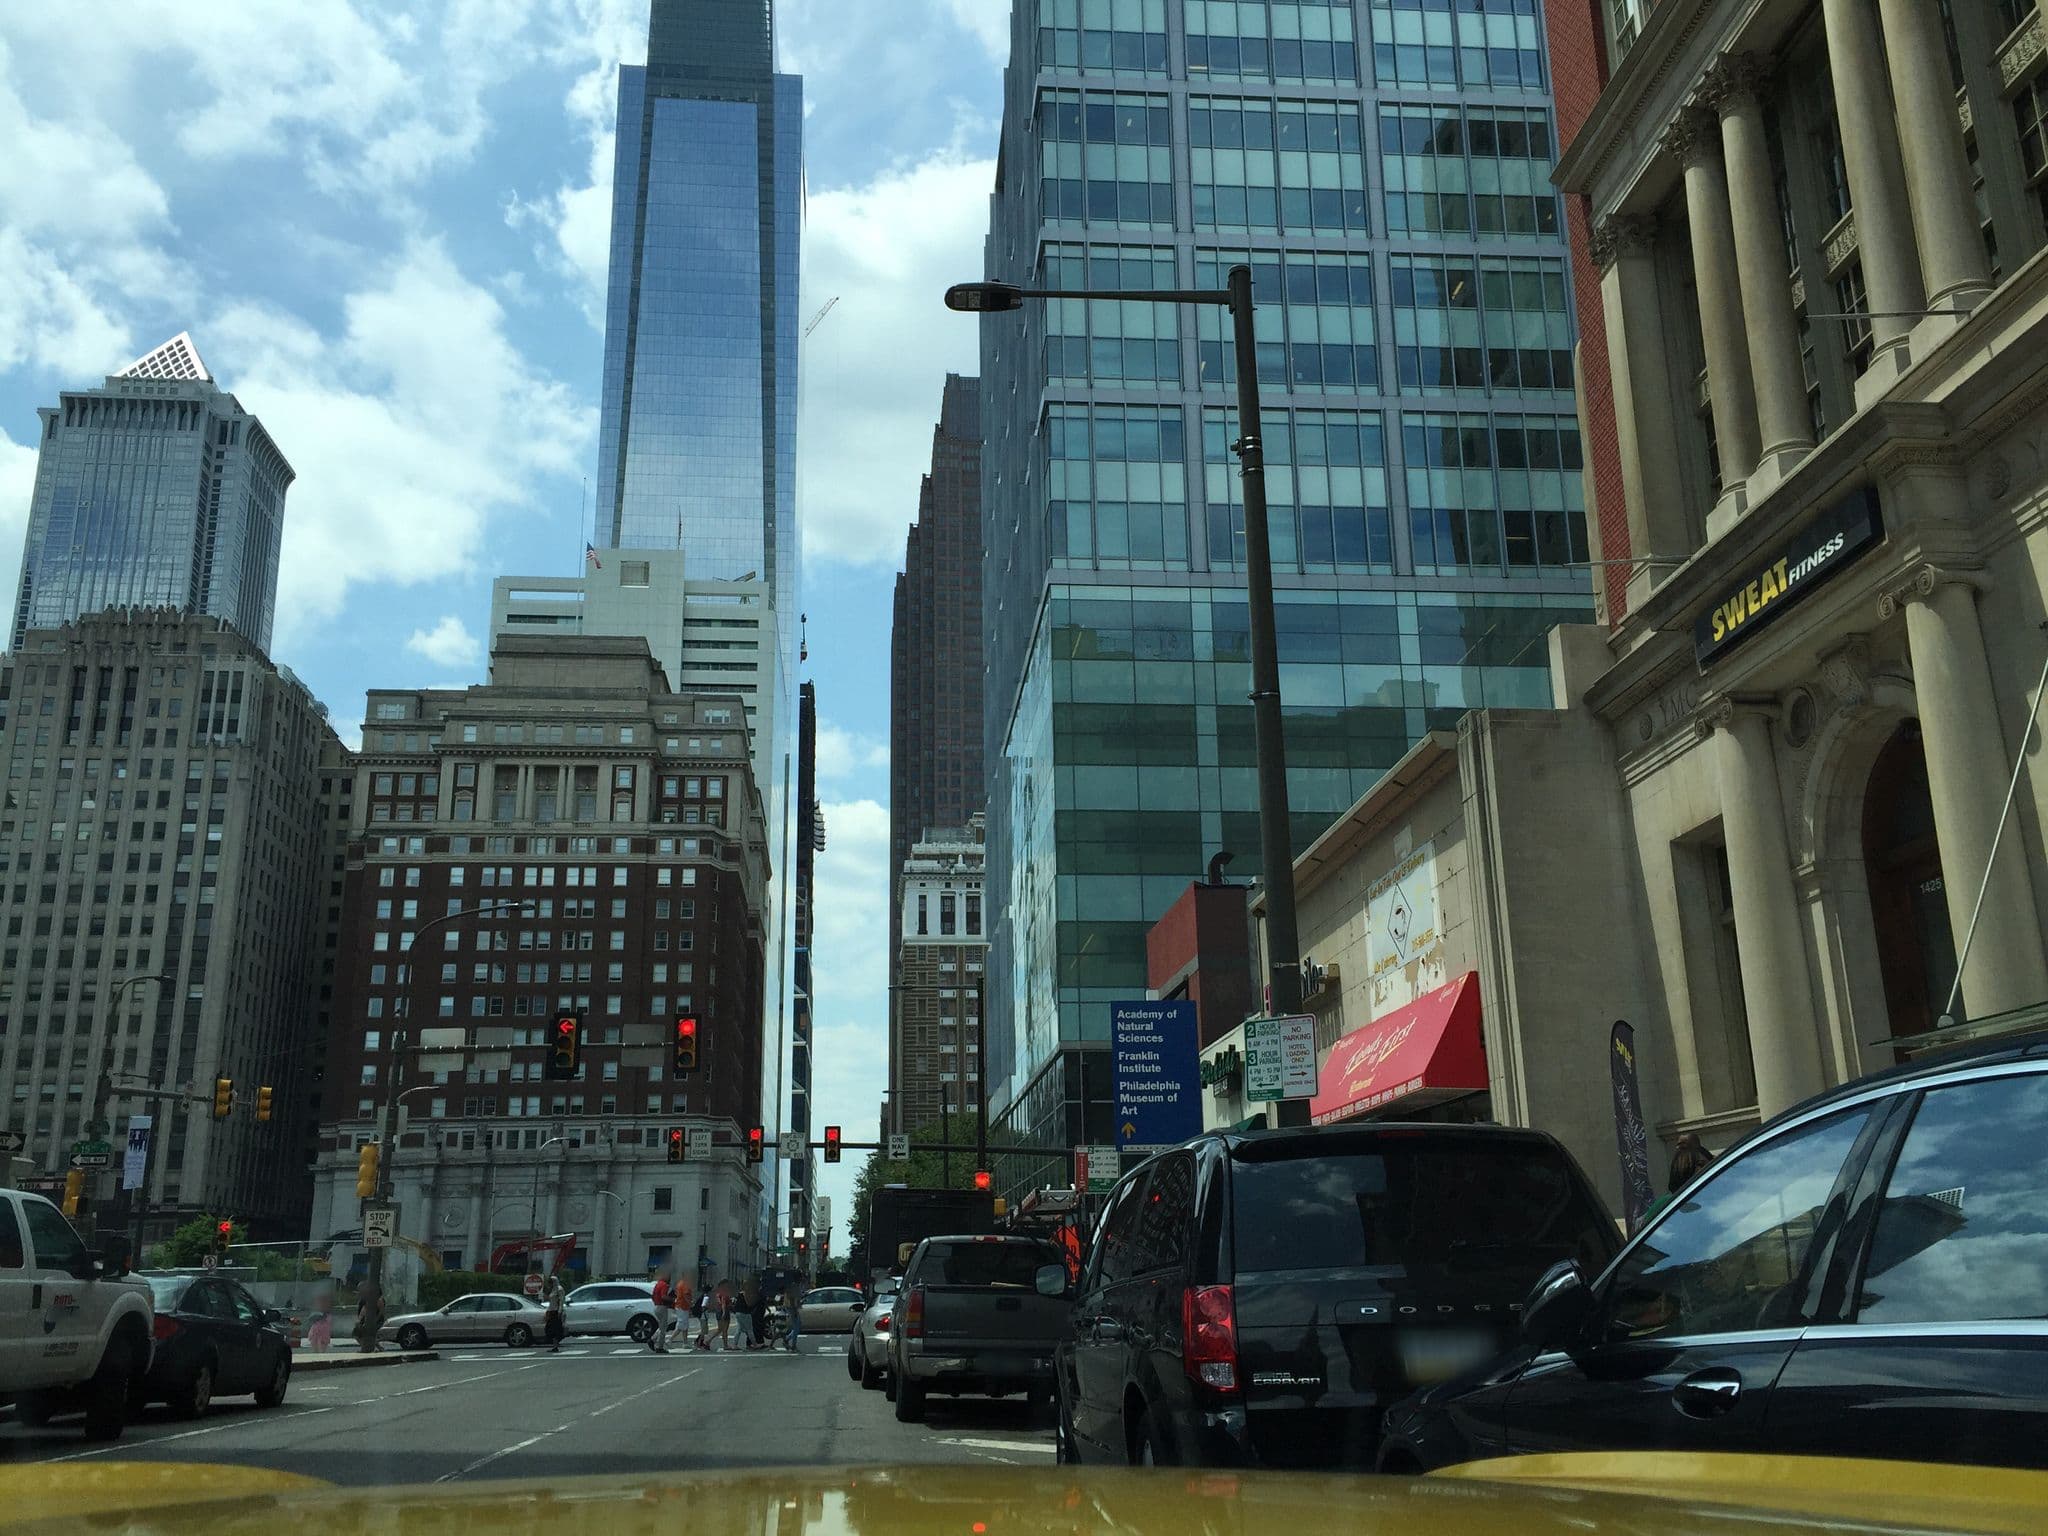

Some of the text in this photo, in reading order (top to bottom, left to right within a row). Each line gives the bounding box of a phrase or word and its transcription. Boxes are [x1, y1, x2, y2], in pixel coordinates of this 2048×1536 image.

[1711, 532, 1844, 642] SWEAT FITNESS
[1116, 1009, 1177, 1021] Academy of
[1116, 1021, 1154, 1031] Natural
[1247, 1025, 1255, 1037] 2
[1118, 1033, 1164, 1043] Sciences
[1282, 1033, 1312, 1041] PARKING
[1118, 1051, 1160, 1061] Franklin
[1248, 1050, 1278, 1065] 3 HOUR
[1285, 1049, 1310, 1058] LOADING
[1118, 1063, 1162, 1073] Institute
[1119, 1081, 1181, 1092] Philadelphia
[1119, 1093, 1178, 1103] Museum of
[1120, 1106, 1138, 1116] Art
[892, 1135, 905, 1143] ONE
[369, 1212, 391, 1221] STOP
[366, 1237, 382, 1245] RED
[1360, 1303, 1524, 1315] DODGE
